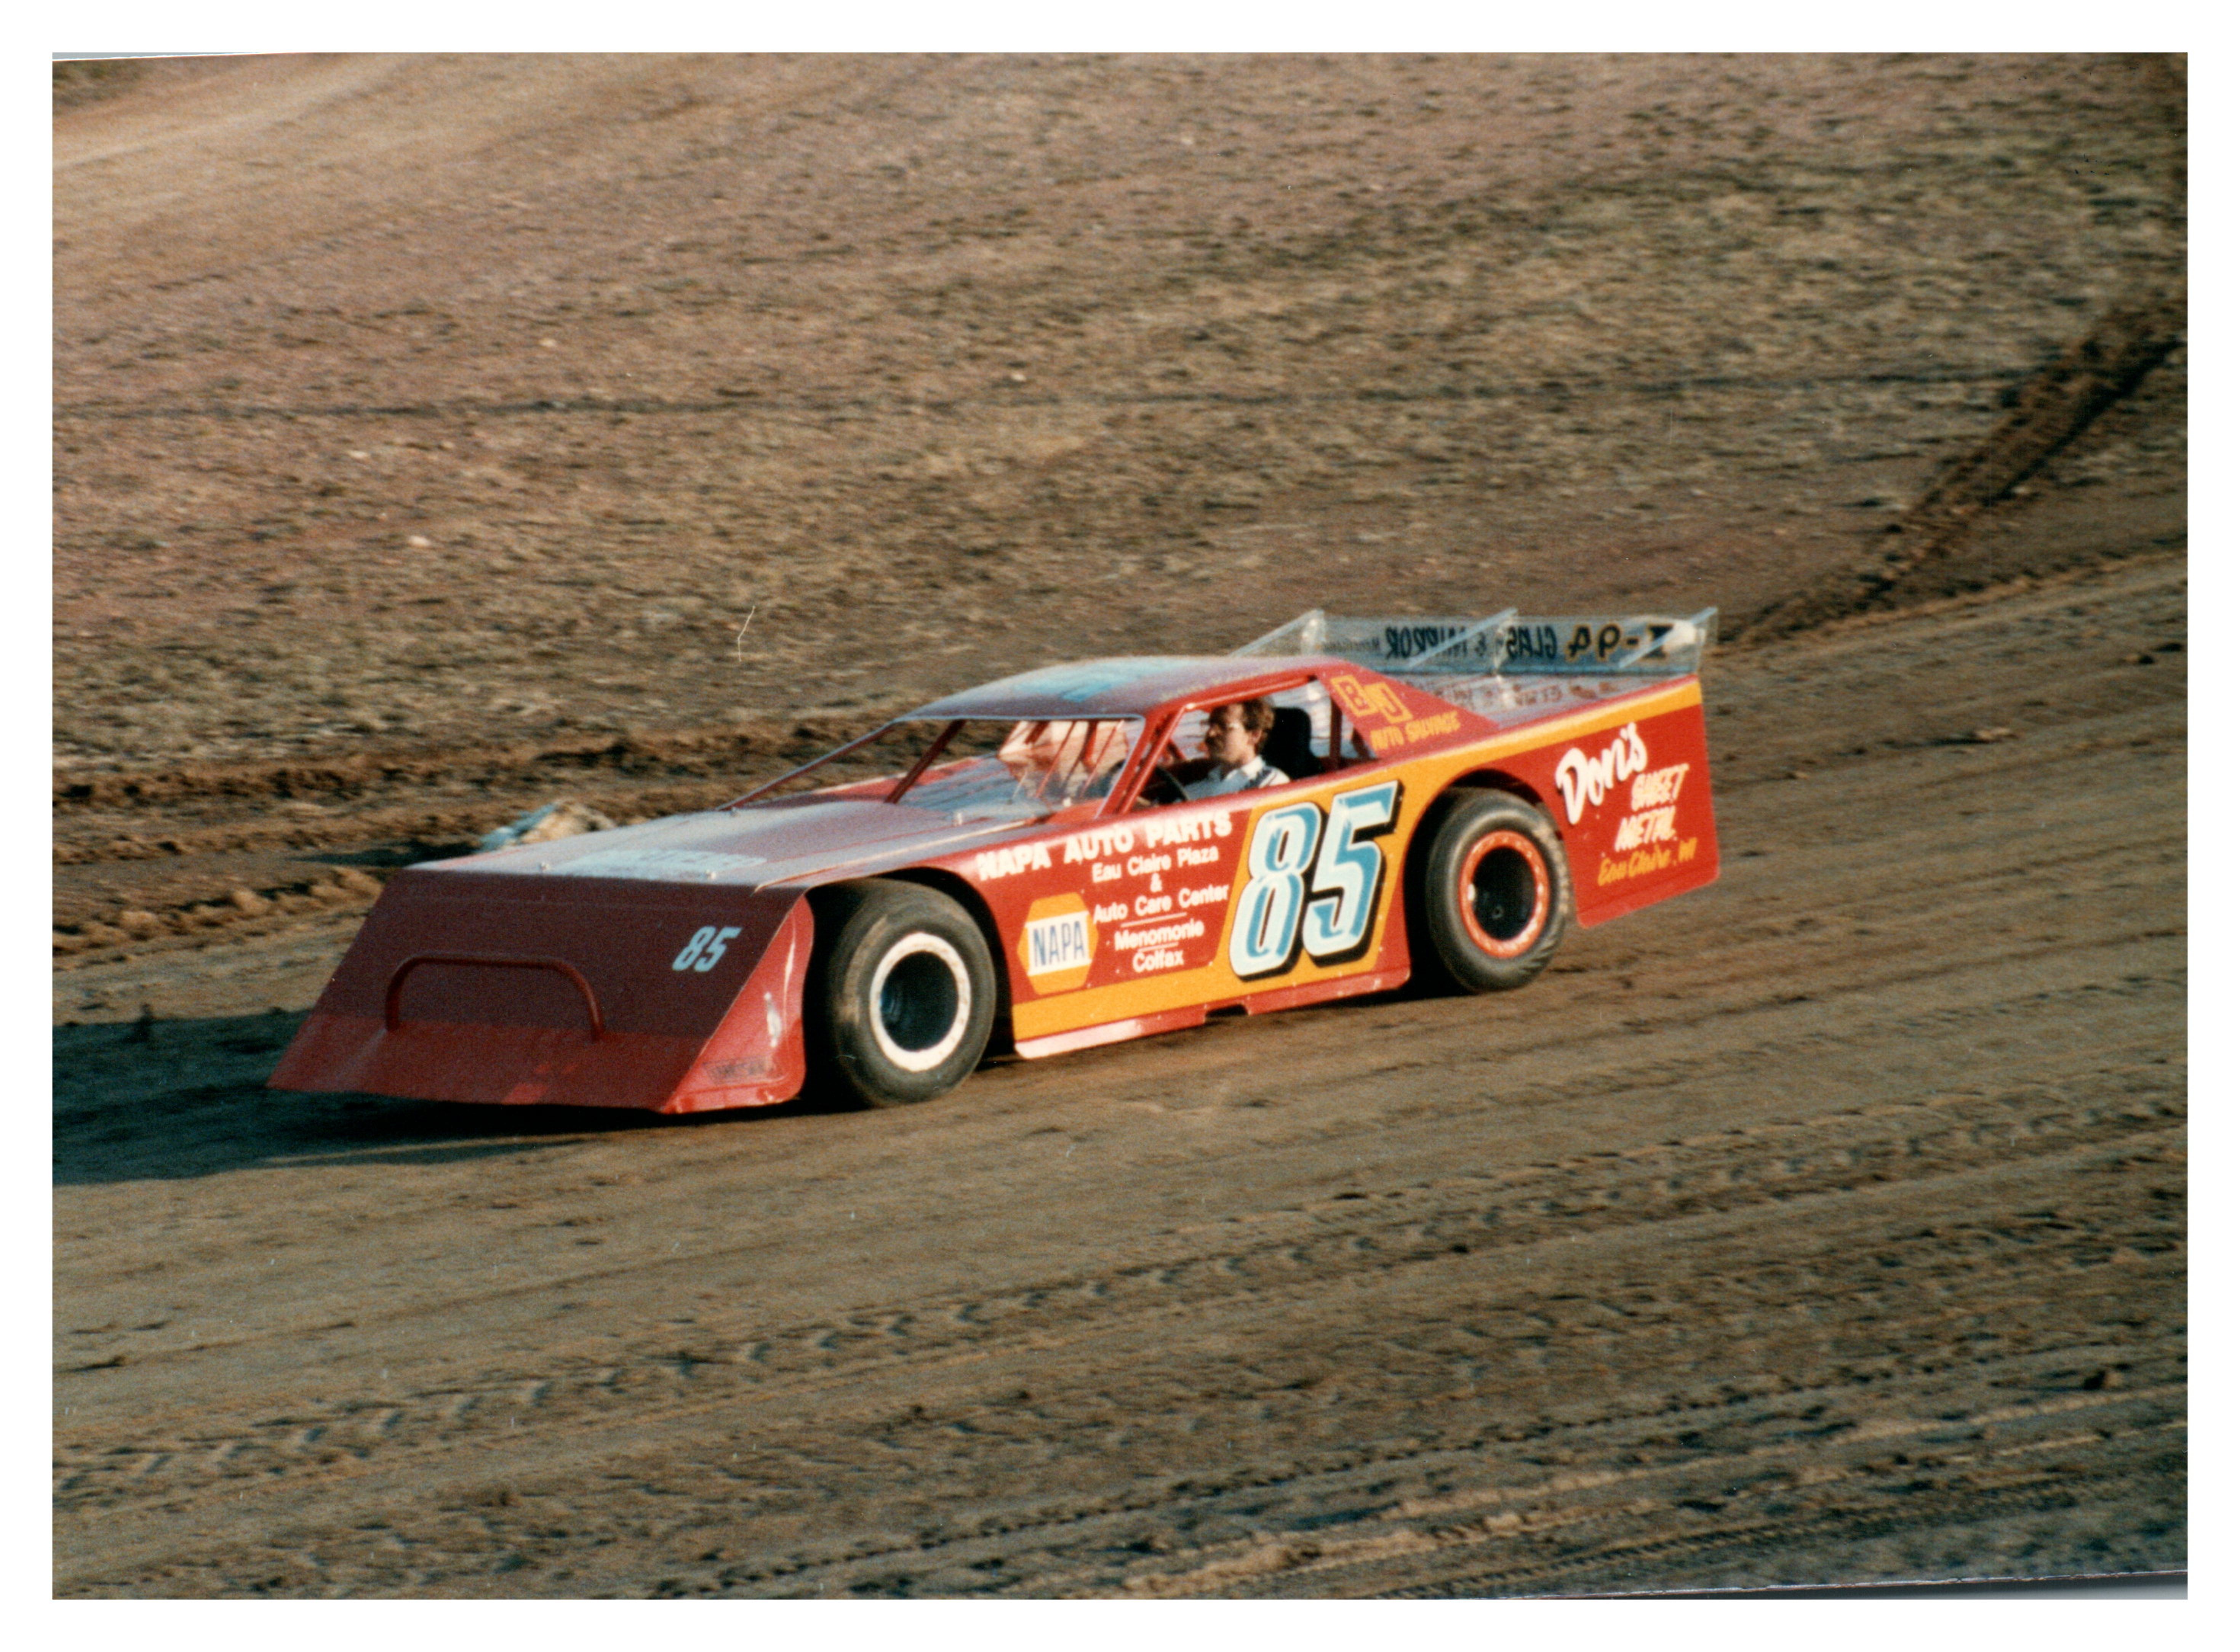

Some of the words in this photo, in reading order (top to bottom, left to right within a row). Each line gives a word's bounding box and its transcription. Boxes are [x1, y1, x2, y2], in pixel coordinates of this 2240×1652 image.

[1555, 722, 1648, 825] Don's
[976, 841, 1051, 881] NAPA
[1064, 824, 1134, 864] AUTO
[1145, 810, 1232, 848] PARTS
[1614, 805, 1677, 852] METAL
[1091, 861, 1122, 883] Eau
[1127, 853, 1171, 876] Claire
[1177, 846, 1219, 867] Plaza
[1150, 873, 1163, 893] &
[1229, 779, 1405, 982] 85
[1093, 903, 1128, 925] Auto
[1135, 894, 1172, 916] Care
[1178, 884, 1229, 908] Center
[672, 925, 742, 972] 85
[1033, 920, 1085, 967] NAPA
[1114, 919, 1205, 951] Menomonie
[1132, 948, 1184, 973] Colfax
